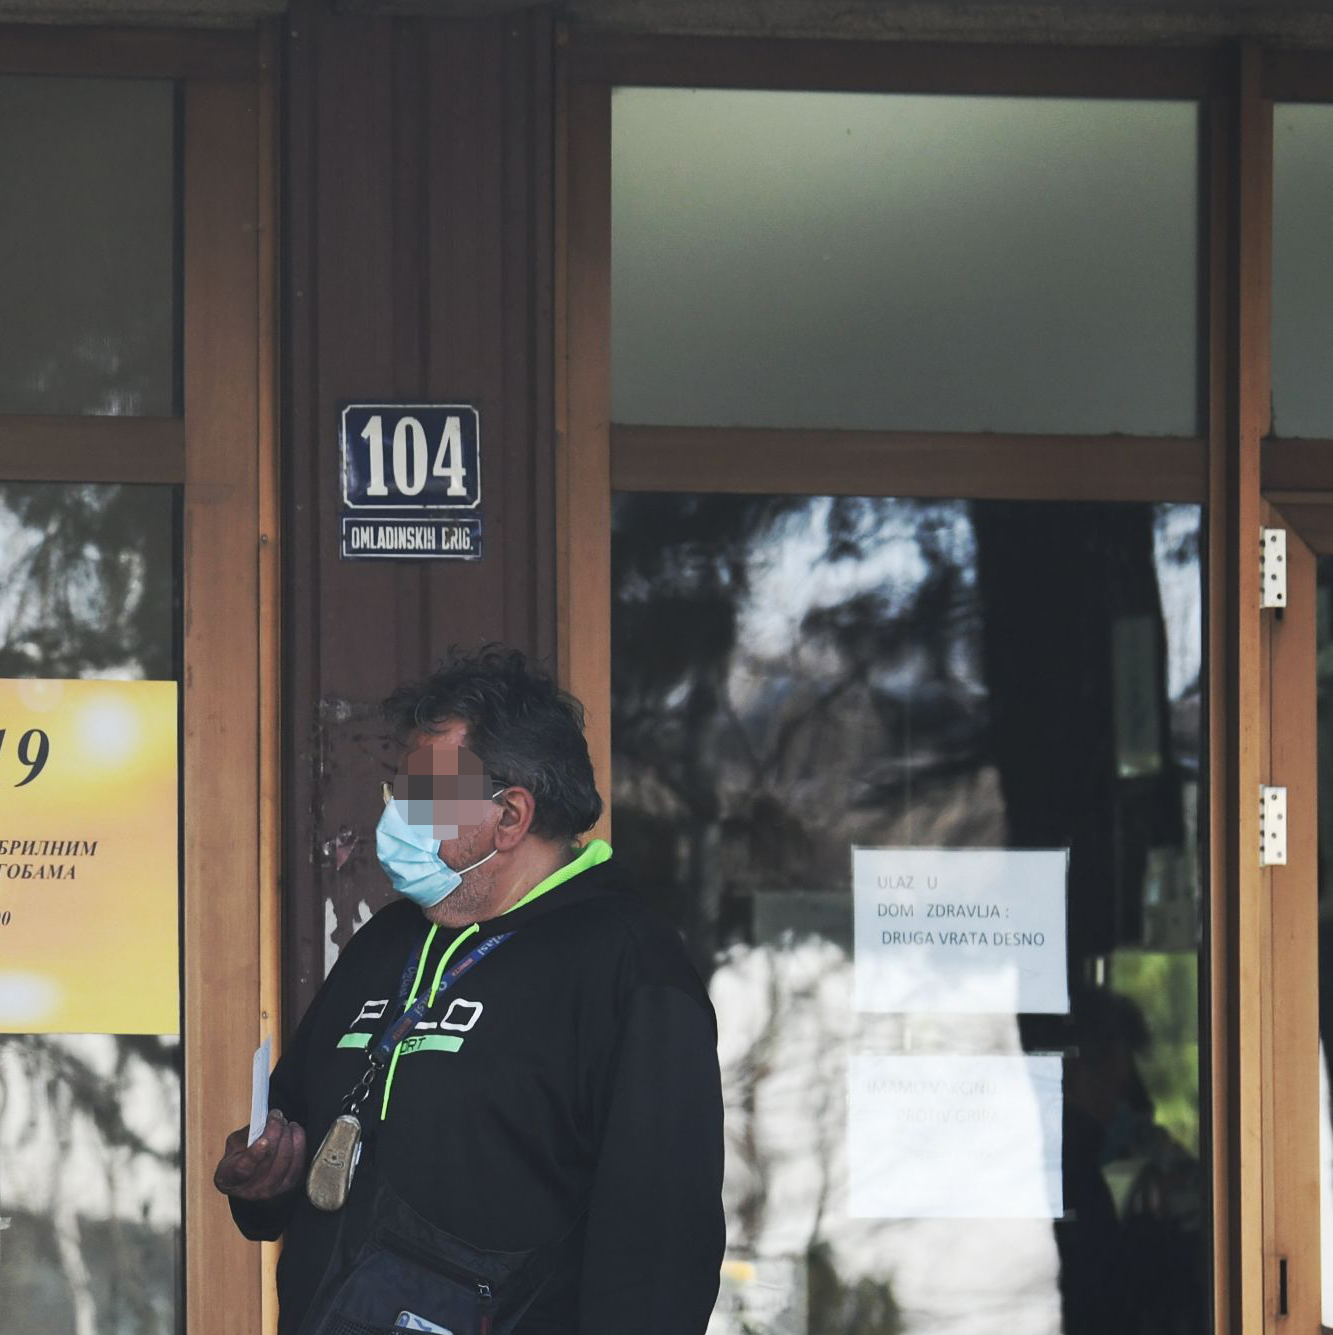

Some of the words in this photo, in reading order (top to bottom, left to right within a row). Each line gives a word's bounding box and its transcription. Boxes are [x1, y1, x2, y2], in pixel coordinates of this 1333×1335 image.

[360, 414, 467, 497] 104
[351, 526, 436, 550] OMLADINSKIH
[877, 875, 914, 889] ULAZ
[927, 875, 938, 889] U
[877, 903, 914, 918] DOM
[926, 903, 1001, 919] ZDRAVLJA
[881, 930, 934, 945] DRUGA
[938, 931, 988, 946] VRATA
[993, 932, 1045, 947] DESNO
